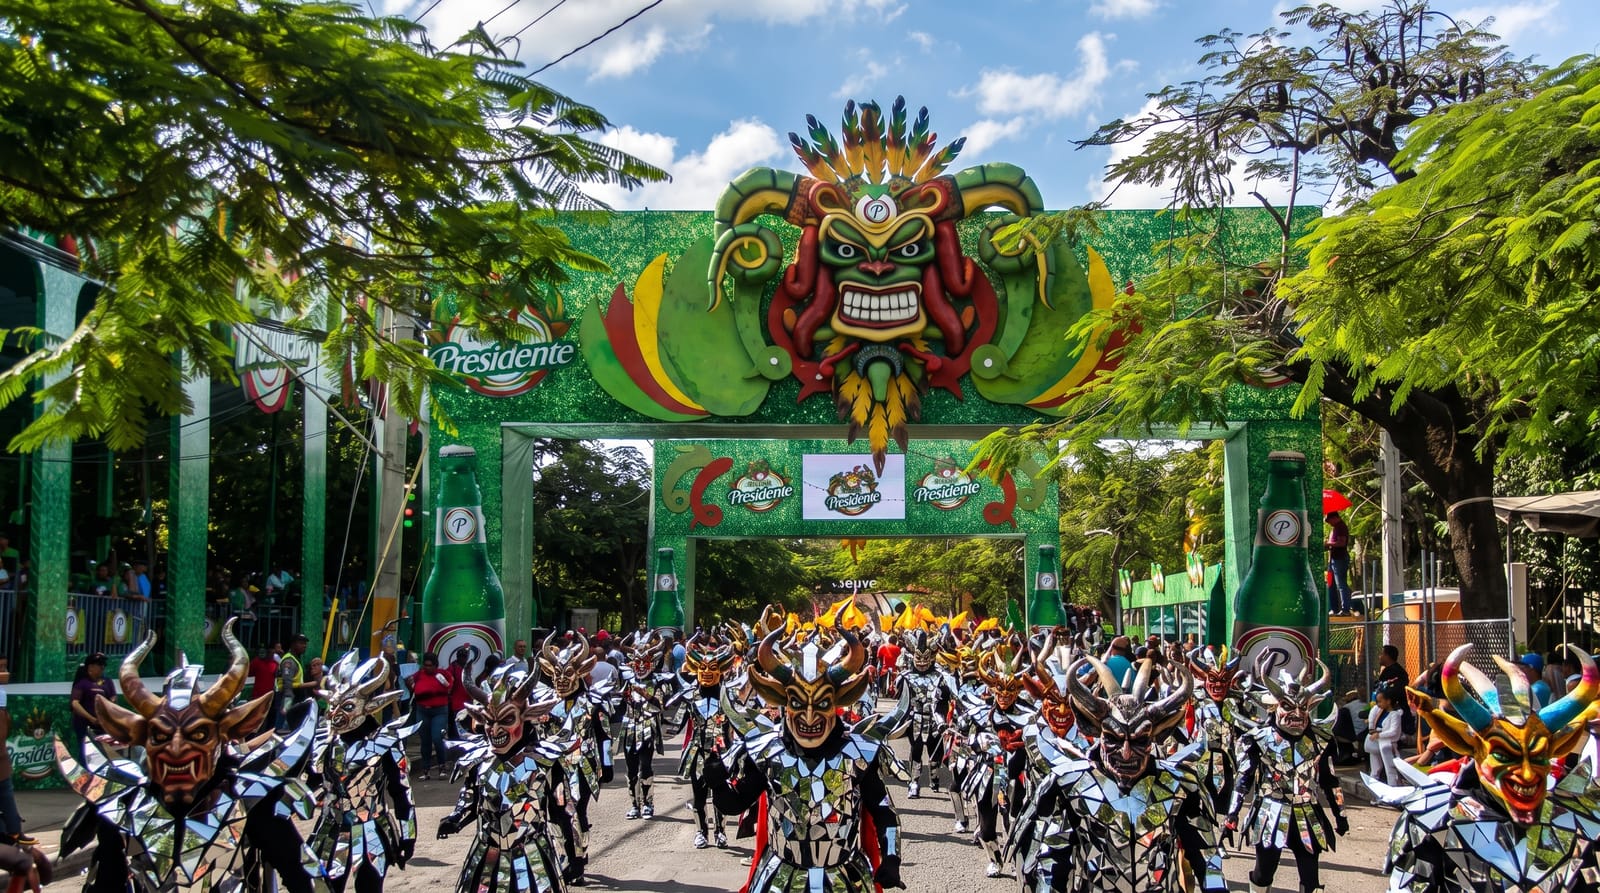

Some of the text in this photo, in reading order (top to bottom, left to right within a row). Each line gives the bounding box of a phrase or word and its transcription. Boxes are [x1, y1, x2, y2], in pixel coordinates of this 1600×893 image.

[870, 204, 884, 219] P
[431, 341, 574, 375] Presidente
[727, 486, 793, 505] Presidente
[826, 492, 880, 509] Presidente
[913, 483, 980, 502] Presidente
[451, 517, 467, 534] P
[1273, 520, 1290, 535] P
[116, 617, 124, 632] P
